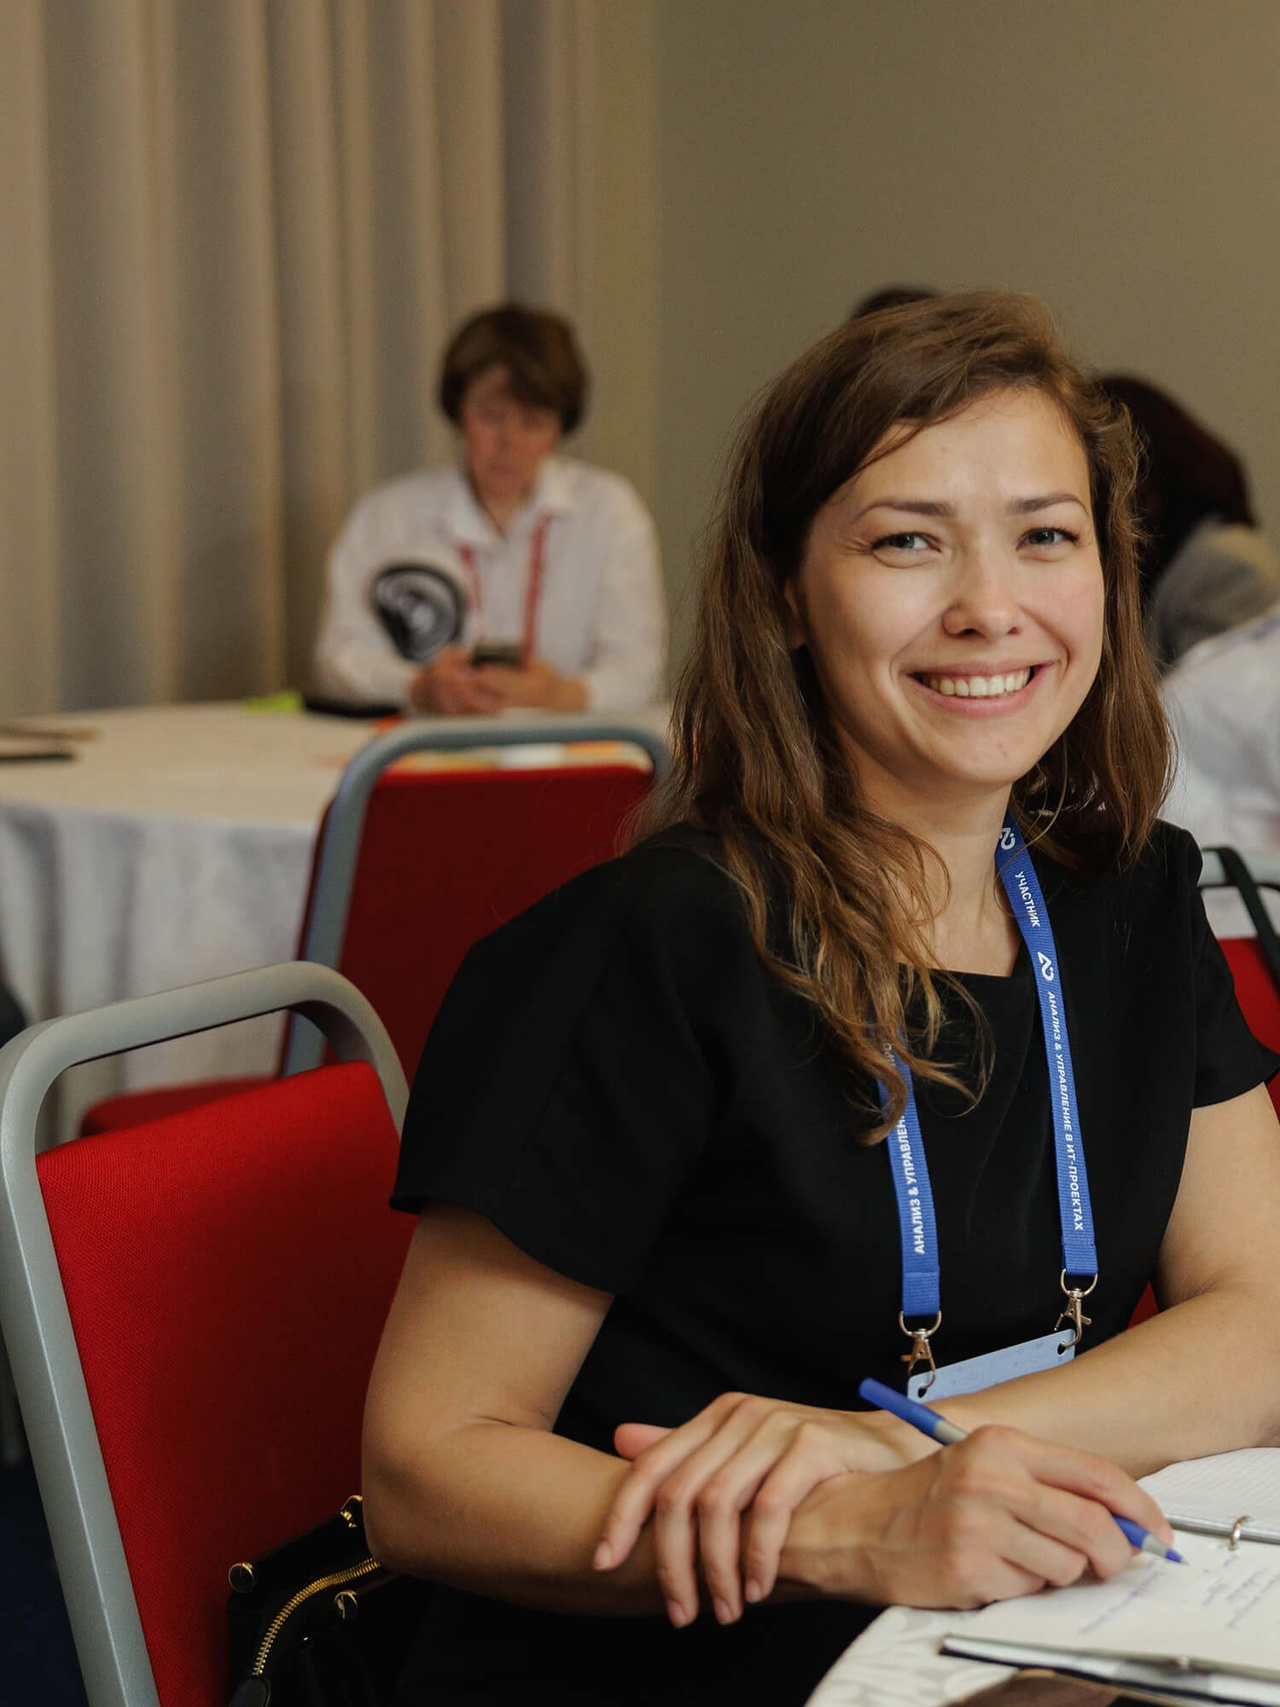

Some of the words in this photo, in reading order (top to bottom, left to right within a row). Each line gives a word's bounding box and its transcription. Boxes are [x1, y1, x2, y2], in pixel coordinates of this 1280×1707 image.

[1014, 870, 1041, 928] УЧАСТНИК
[1048, 991, 1062, 1041] АНАЛИЗ
[1054, 1042, 1062, 1050] &
[1055, 1053, 1073, 1131] УПРАВЛЕНИЕ
[897, 1114, 917, 1185] УПРАВЛЕН
[1065, 1133, 1073, 1141] В
[908, 1186, 919, 1195] &
[1066, 1144, 1084, 1231] ИТ-ПРОЕКТАХ
[909, 1198, 926, 1255] АНАЛИЗ
